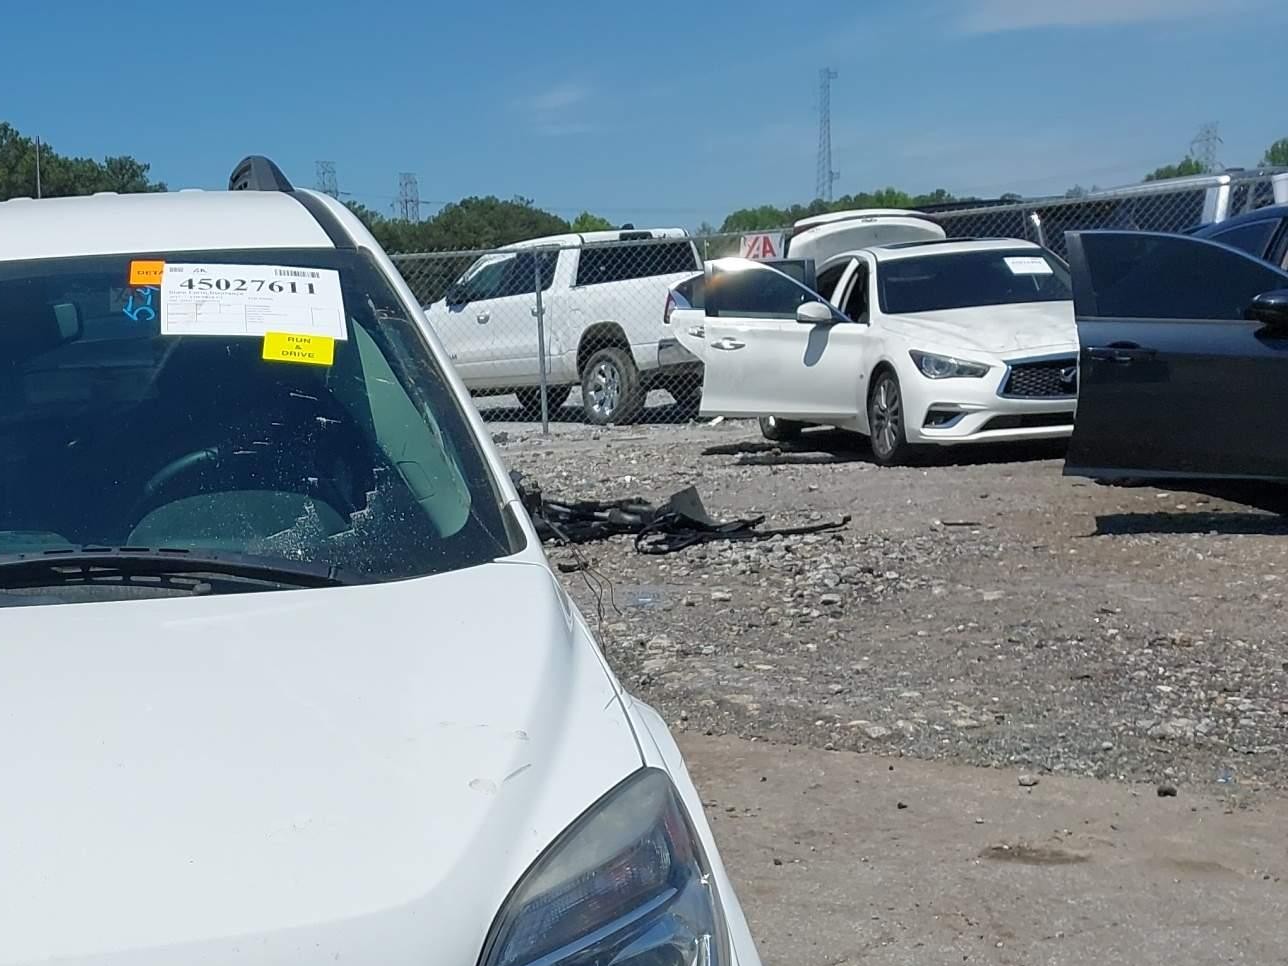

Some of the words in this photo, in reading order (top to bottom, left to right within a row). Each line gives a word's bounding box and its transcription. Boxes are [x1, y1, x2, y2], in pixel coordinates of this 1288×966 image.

[179, 277, 317, 295] 45027611
[287, 336, 311, 344] RUN
[281, 350, 315, 358] DRIVE
